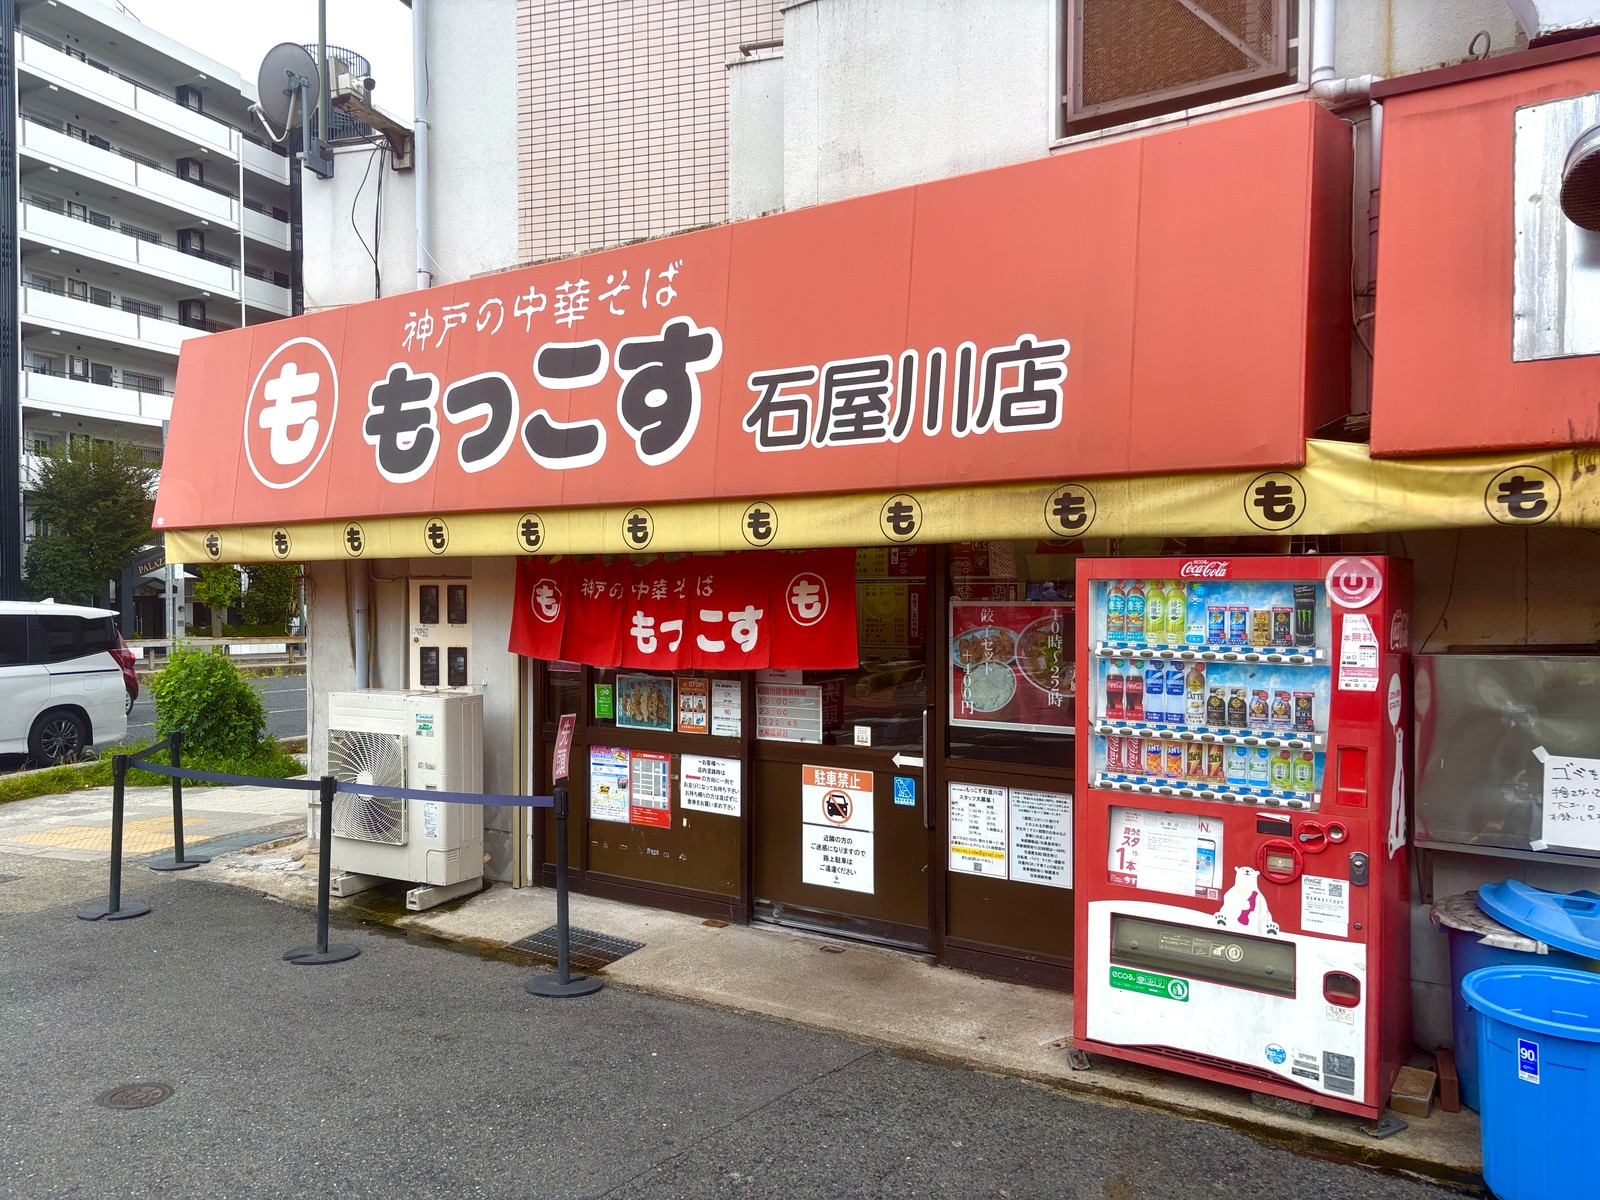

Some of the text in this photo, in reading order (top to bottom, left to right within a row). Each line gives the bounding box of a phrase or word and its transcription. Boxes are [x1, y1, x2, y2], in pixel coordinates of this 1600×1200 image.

[402, 259, 684, 352] 神戸の中華そば
[258, 361, 322, 466] も
[364, 316, 1071, 485] もっこす 石屋川店
[1253, 480, 1297, 524] も
[1496, 475, 1546, 519] も
[885, 501, 916, 537] も
[1052, 492, 1087, 529] も
[428, 518, 448, 551] も
[520, 515, 541, 549] も
[628, 513, 649, 545] も
[748, 508, 771, 541] も
[206, 534, 220, 557] も
[275, 531, 289, 555] も
[346, 528, 363, 554] も
[1180, 561, 1230, 578] Coca-Cola
[536, 584, 558, 617] も
[581, 576, 714, 600] 神戸の中華そば
[790, 580, 821, 618] も
[630, 605, 764, 654] もっこす
[556, 719, 570, 775] 先頭
[697, 766, 726, 776] 店内混雑時は
[701, 775, 735, 786] の方向に一列で
[814, 769, 861, 789] 駐車禁止
[1552, 762, 1598, 780] ゴミを
[683, 781, 740, 795] お並びになってお待ち下さい
[685, 790, 738, 803] お持ち帰りの方は並ばずに
[687, 798, 736, 811] 食券をお買い求め下さい
[810, 842, 866, 858] ご迷惑になりますので
[823, 834, 853, 845] 近隣の方の
[820, 864, 857, 876] ご遠慮ください
[823, 854, 853, 866] 路上駐車は
